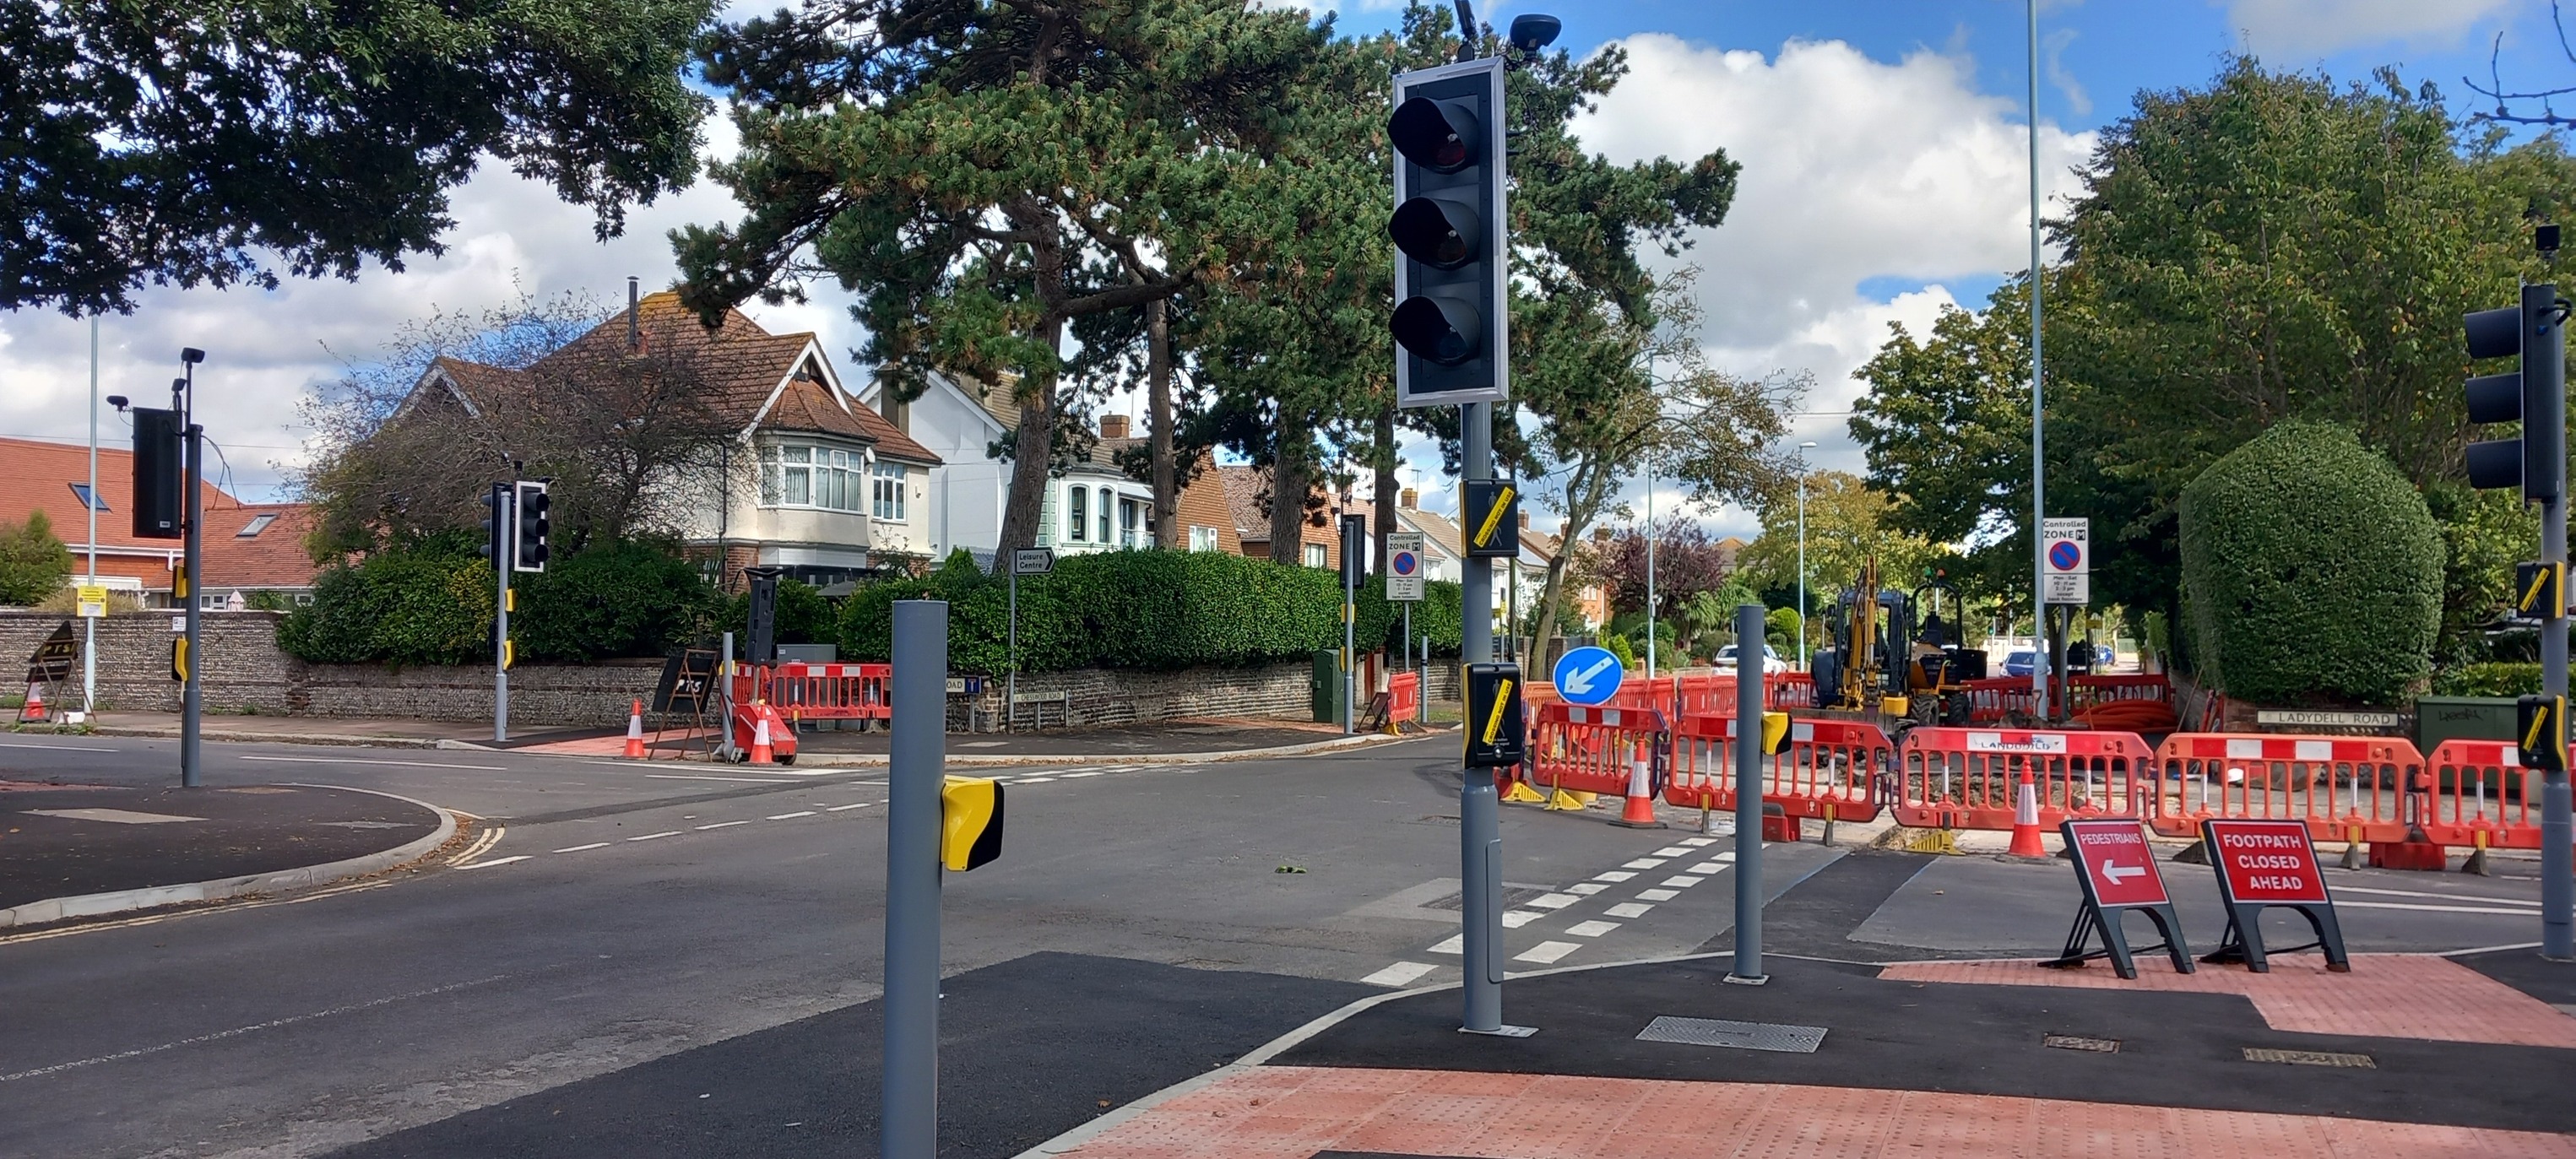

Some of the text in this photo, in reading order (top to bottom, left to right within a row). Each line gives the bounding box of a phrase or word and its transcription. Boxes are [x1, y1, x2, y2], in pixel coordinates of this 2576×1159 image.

[2044, 530, 2074, 539] ZONE
[946, 680, 963, 689] OAD
[2279, 712, 2391, 725] LADYDELL ROAD
[2080, 832, 2142, 845] PEDESTRIANS
[2222, 834, 2302, 848] FOOTPATH
[2237, 854, 2300, 869] CLOSED
[2250, 875, 2302, 891] AHEAD
